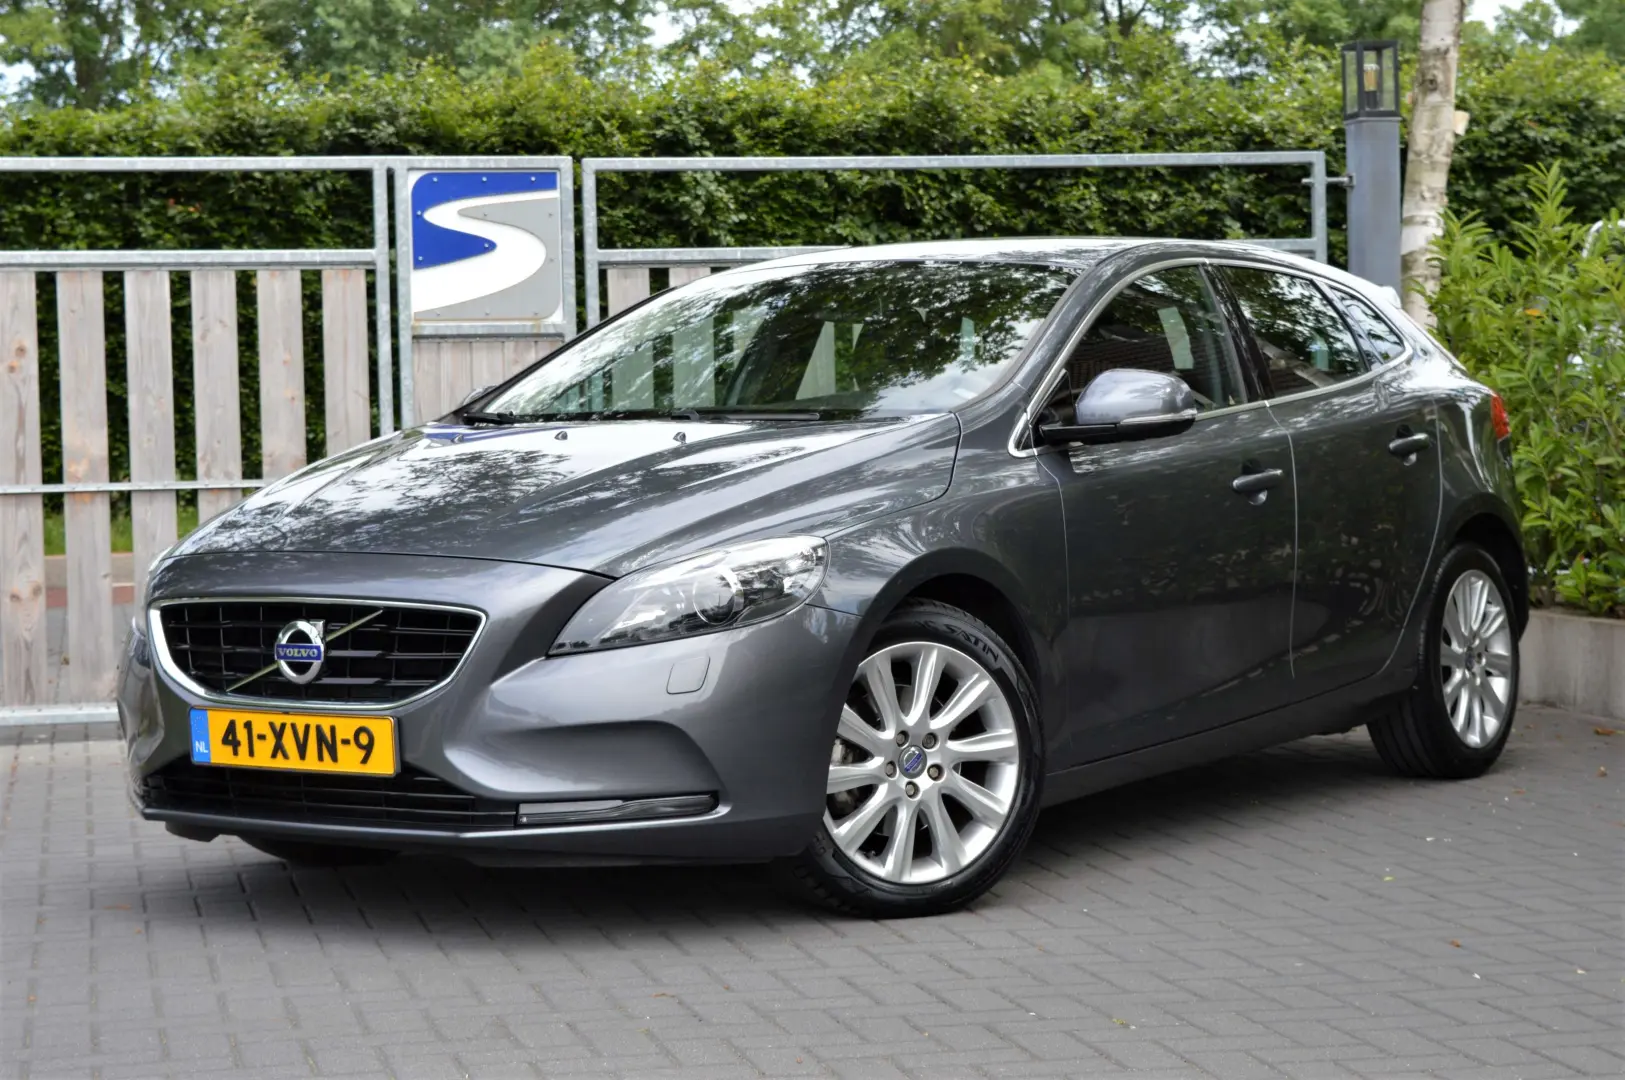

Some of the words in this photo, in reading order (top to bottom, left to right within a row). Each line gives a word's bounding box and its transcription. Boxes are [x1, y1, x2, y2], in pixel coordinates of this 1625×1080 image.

[277, 647, 319, 658] VOLVO
[195, 741, 209, 753] NL
[221, 719, 375, 764] 41-XVN-9
